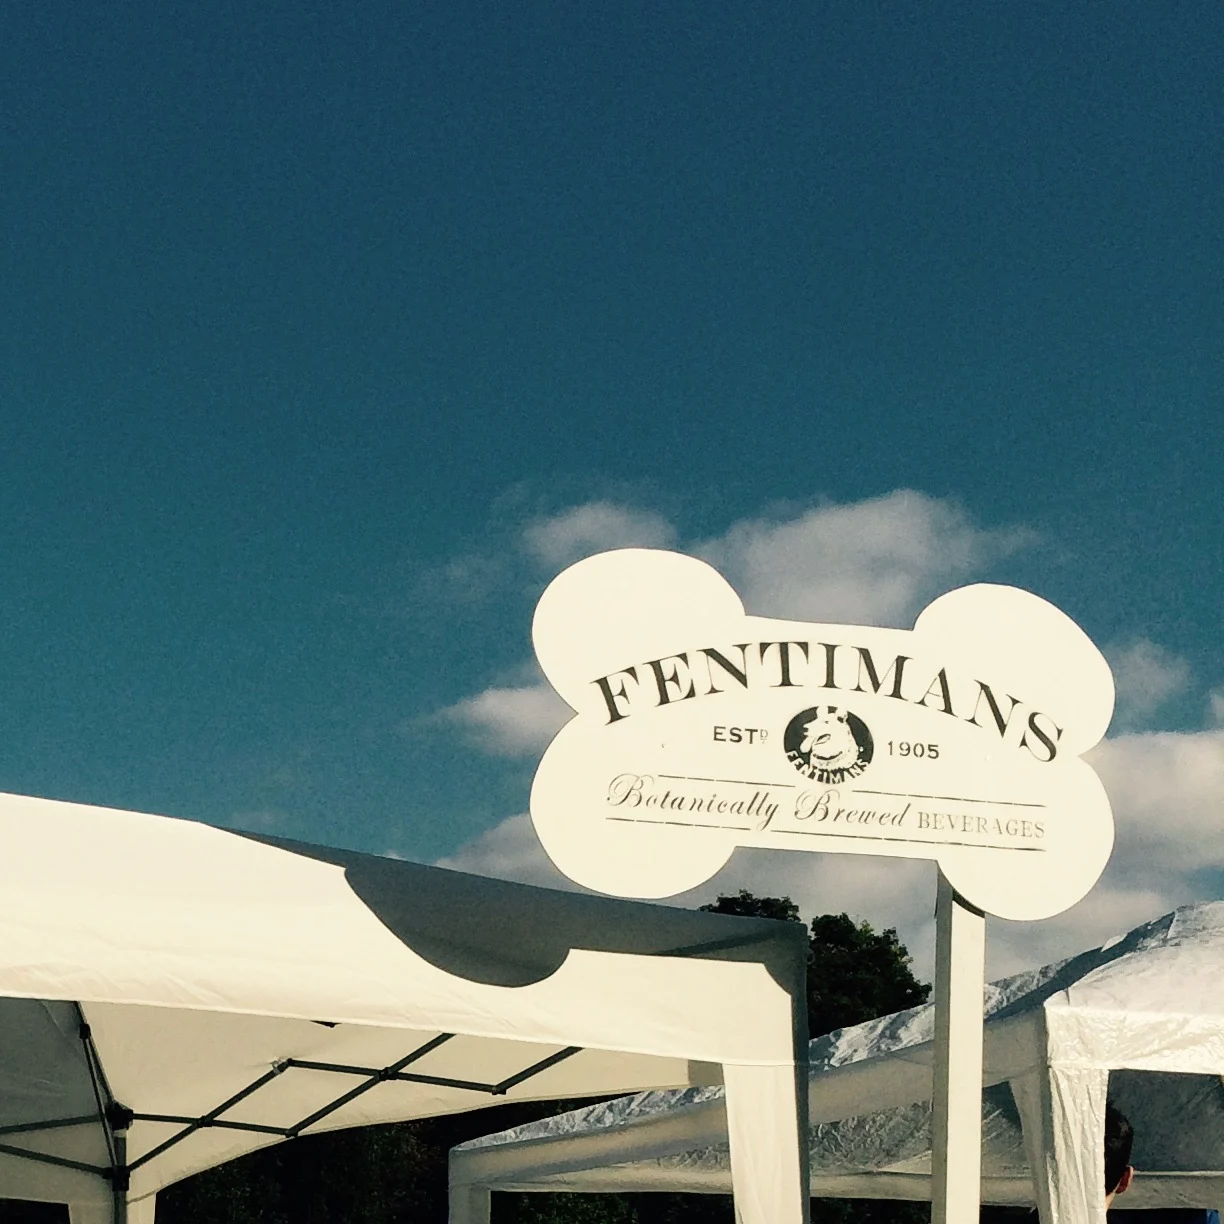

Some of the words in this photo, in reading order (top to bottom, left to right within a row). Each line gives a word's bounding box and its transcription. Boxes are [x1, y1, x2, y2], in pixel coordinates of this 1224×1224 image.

[590, 641, 1064, 764] FENTIMANS
[887, 740, 940, 760] 1905
[606, 772, 780, 831] Botanically
[794, 789, 907, 827] Brewed
[917, 811, 1045, 839] BEVERAGES
